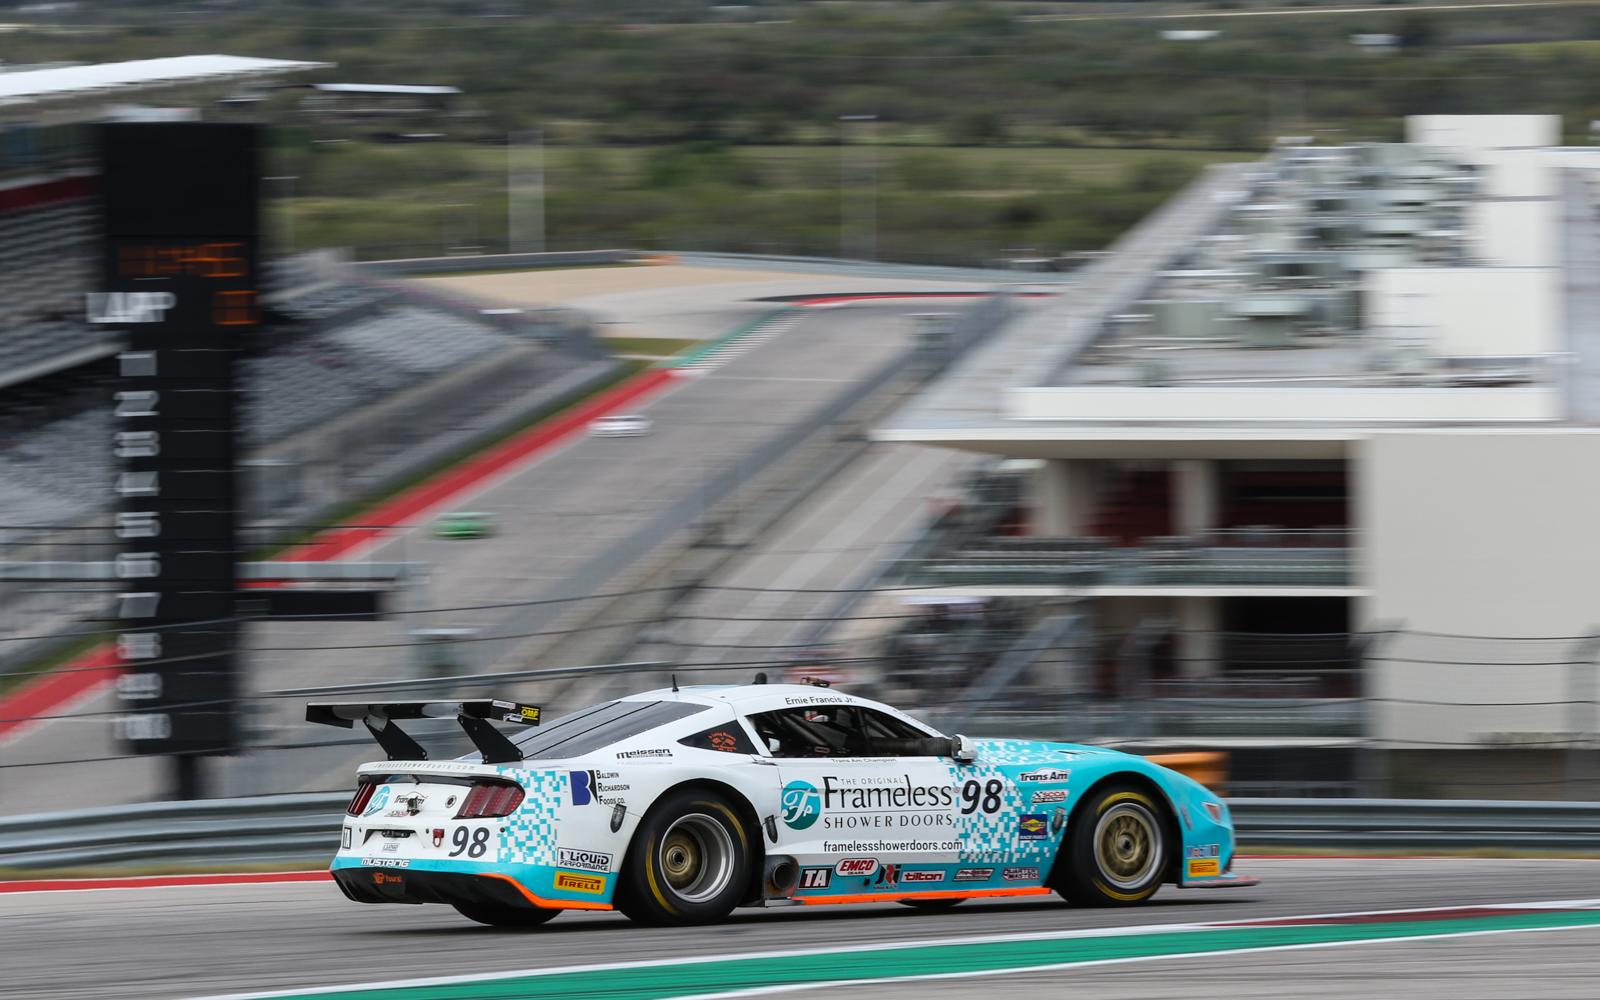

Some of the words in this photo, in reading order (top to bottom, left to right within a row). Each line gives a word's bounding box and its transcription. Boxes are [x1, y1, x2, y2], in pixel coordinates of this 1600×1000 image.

[785, 697, 808, 705] Ernie
[810, 695, 843, 704] Francis
[520, 708, 538, 718] OMP
[841, 778, 857, 786] THE
[860, 777, 904, 785] ORIGINAL
[1020, 773, 1048, 781] Trans
[1049, 771, 1068, 780] Am
[597, 783, 631, 792] RICHARDSON
[822, 774, 953, 809] Frameless
[961, 779, 1003, 815] 98
[824, 816, 893, 829] SHOWER
[900, 814, 953, 827] DOORS
[448, 825, 490, 858] 98
[823, 839, 963, 852] framelessshowerdoors.com
[360, 858, 411, 868] MUSTANG
[560, 860, 609, 871] PERFORMANCE
[839, 859, 875, 872] EMCO
[558, 875, 602, 890] PIRELLI
[803, 869, 828, 888] TA
[904, 872, 943, 881] tilton
